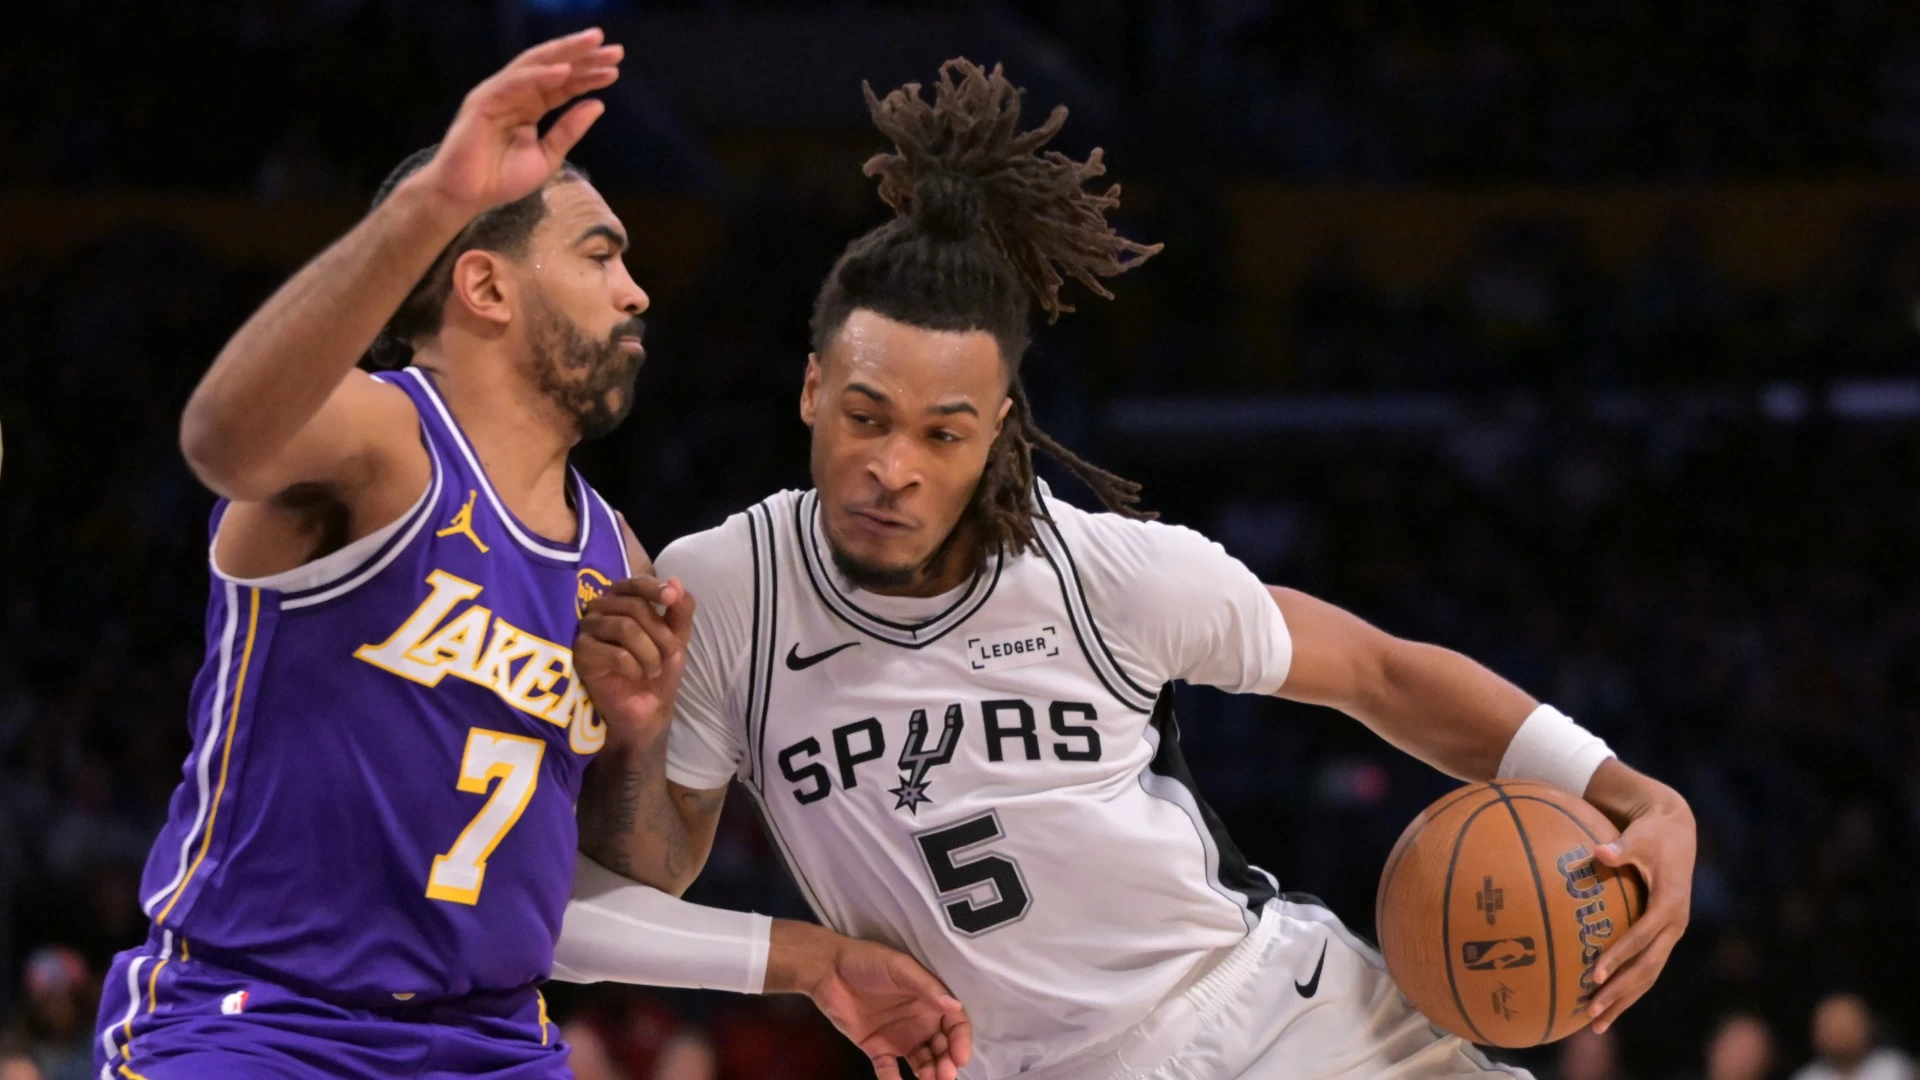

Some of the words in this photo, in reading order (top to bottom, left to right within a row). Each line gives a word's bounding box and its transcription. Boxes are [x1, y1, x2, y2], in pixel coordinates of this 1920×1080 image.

[980, 637, 1046, 659] LEDGER
[425, 726, 547, 906] 7
[778, 698, 1102, 816] SPURS
[910, 806, 1035, 939] 5
